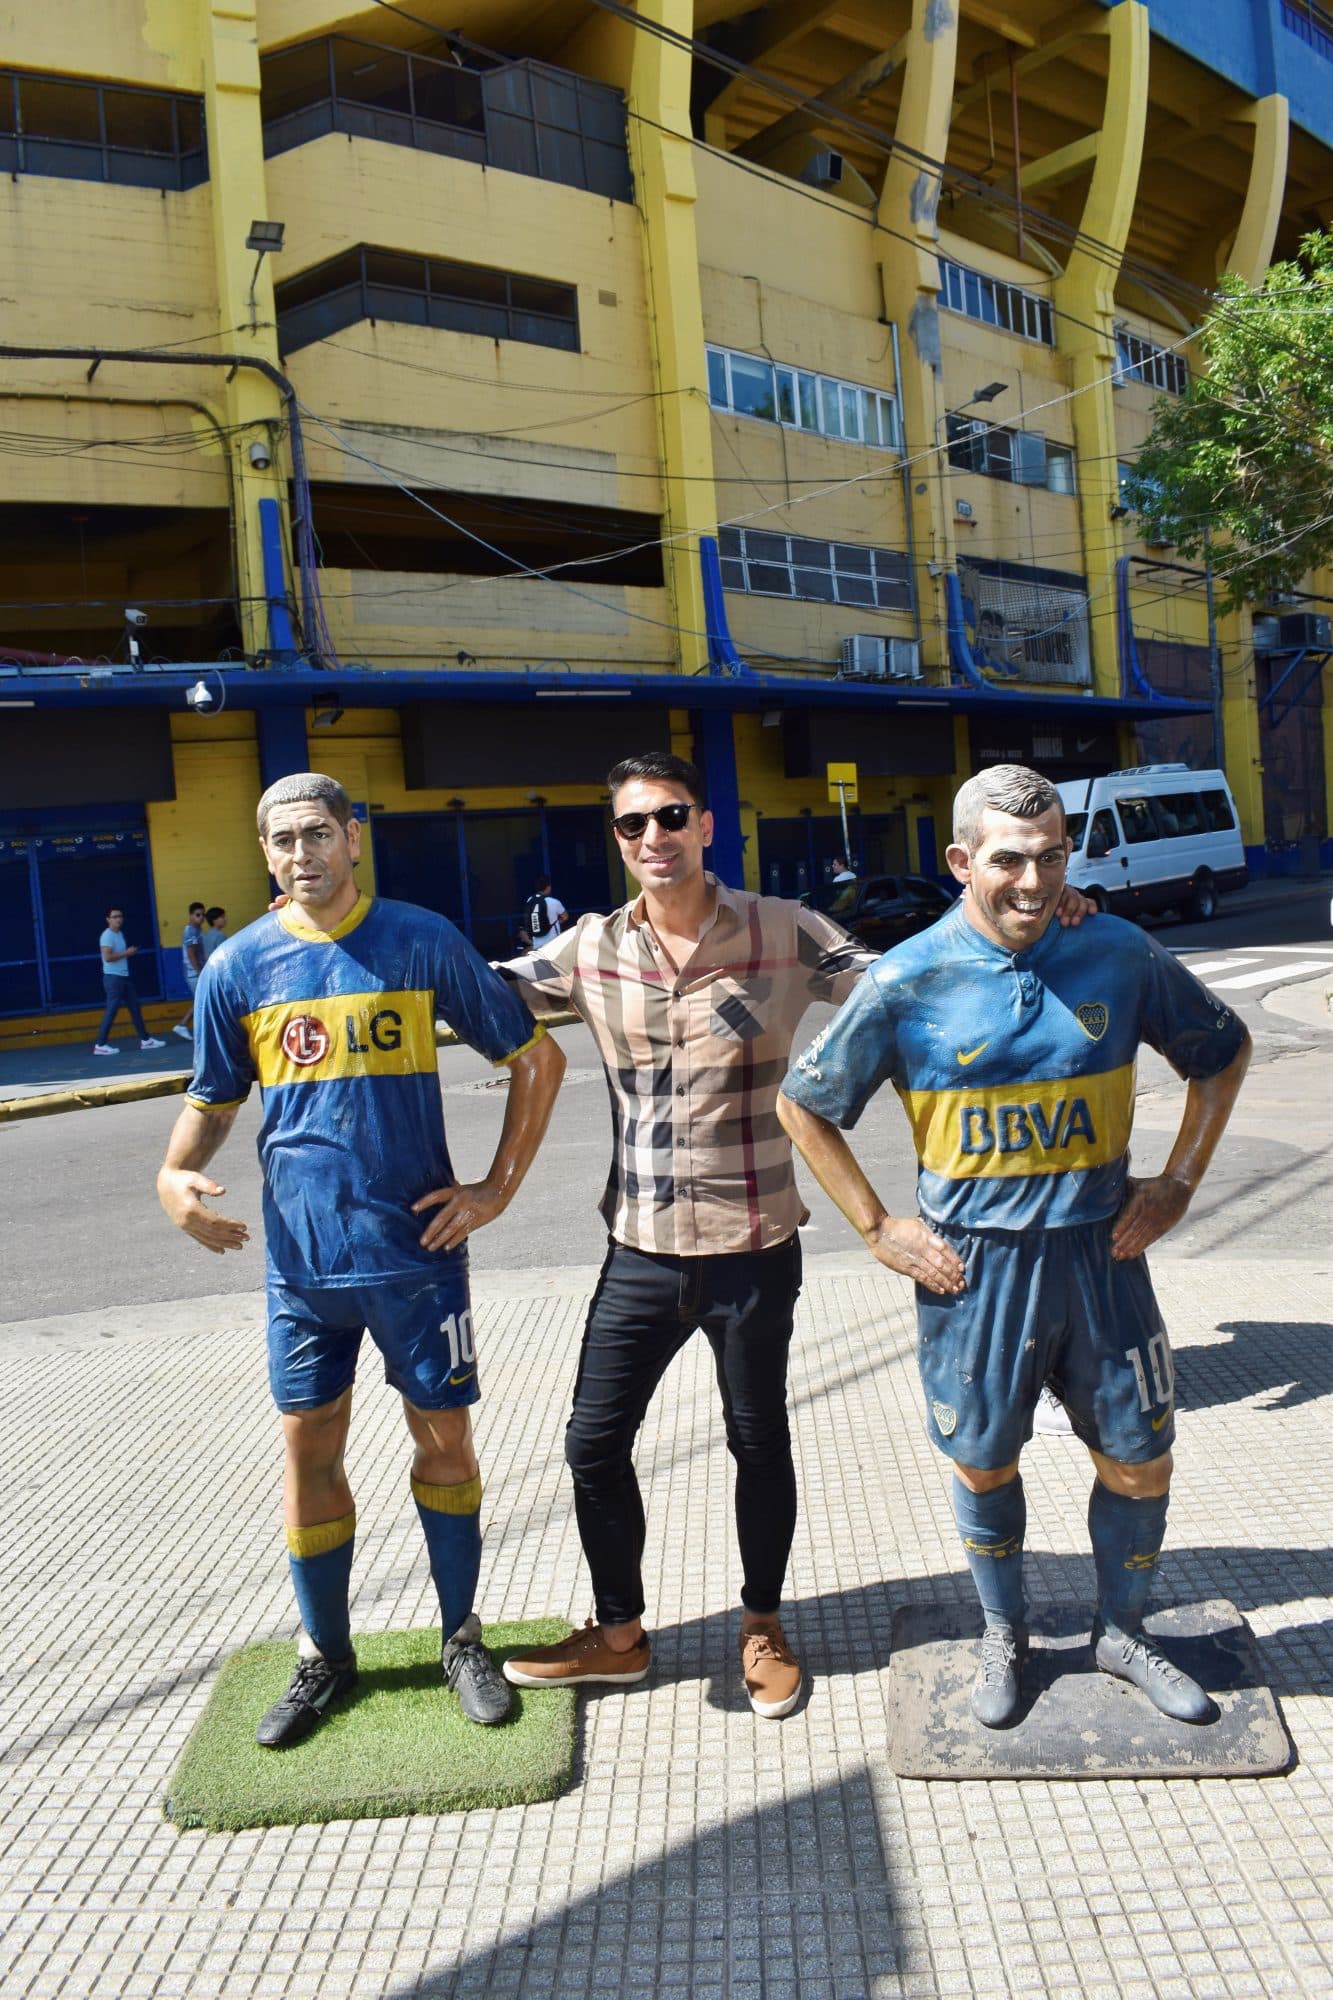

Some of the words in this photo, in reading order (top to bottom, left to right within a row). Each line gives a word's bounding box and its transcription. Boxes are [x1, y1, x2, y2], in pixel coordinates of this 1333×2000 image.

[345, 1010, 402, 1052] LG
[960, 1097, 1097, 1154] BBVA
[440, 1308, 475, 1369] 10
[1125, 1332, 1174, 1413] 10
